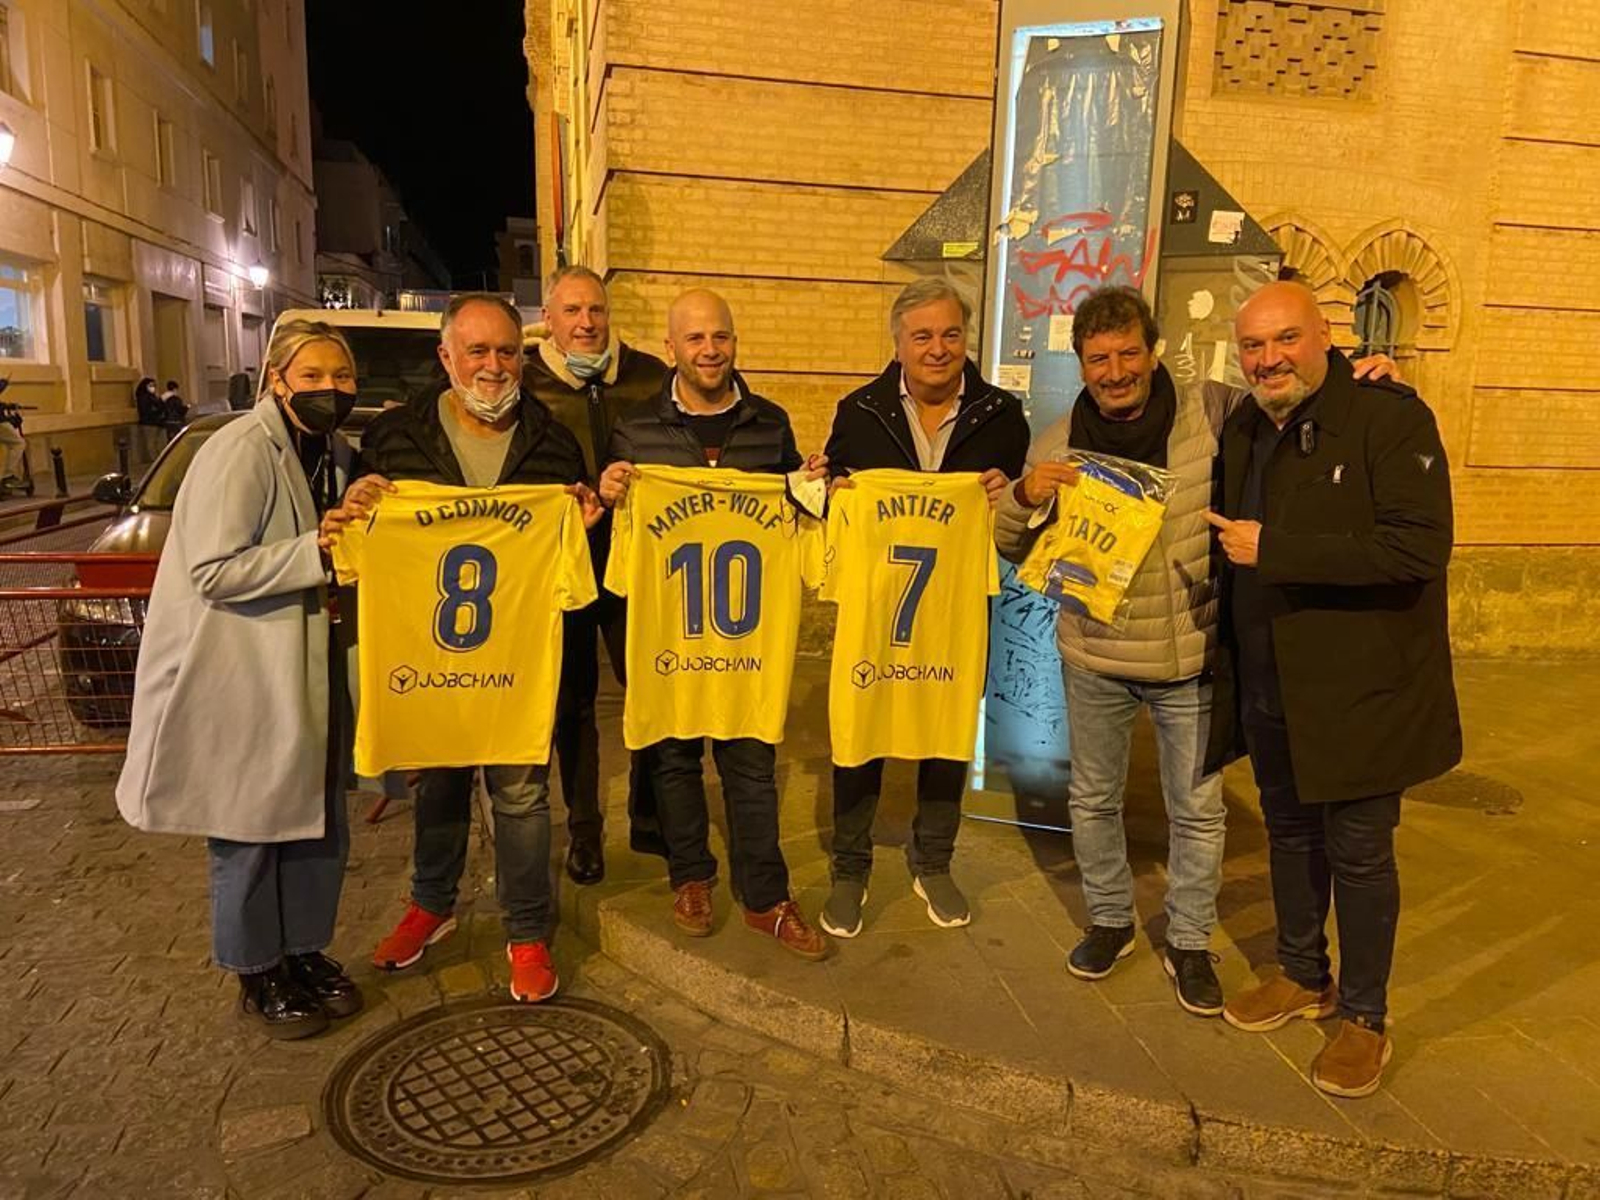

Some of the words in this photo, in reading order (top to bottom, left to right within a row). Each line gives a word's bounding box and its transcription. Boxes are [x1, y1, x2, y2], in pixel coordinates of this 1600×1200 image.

[415, 499, 534, 532] OCONNOR
[647, 492, 782, 540] MAYER-WOLF
[876, 494, 956, 525] ANTIER
[1066, 514, 1118, 553] TATO
[432, 543, 498, 653] 8
[666, 540, 763, 640] 10
[888, 544, 938, 647] 7
[419, 672, 515, 689] JOBCHAIN
[681, 655, 762, 673] JOBCHAIN
